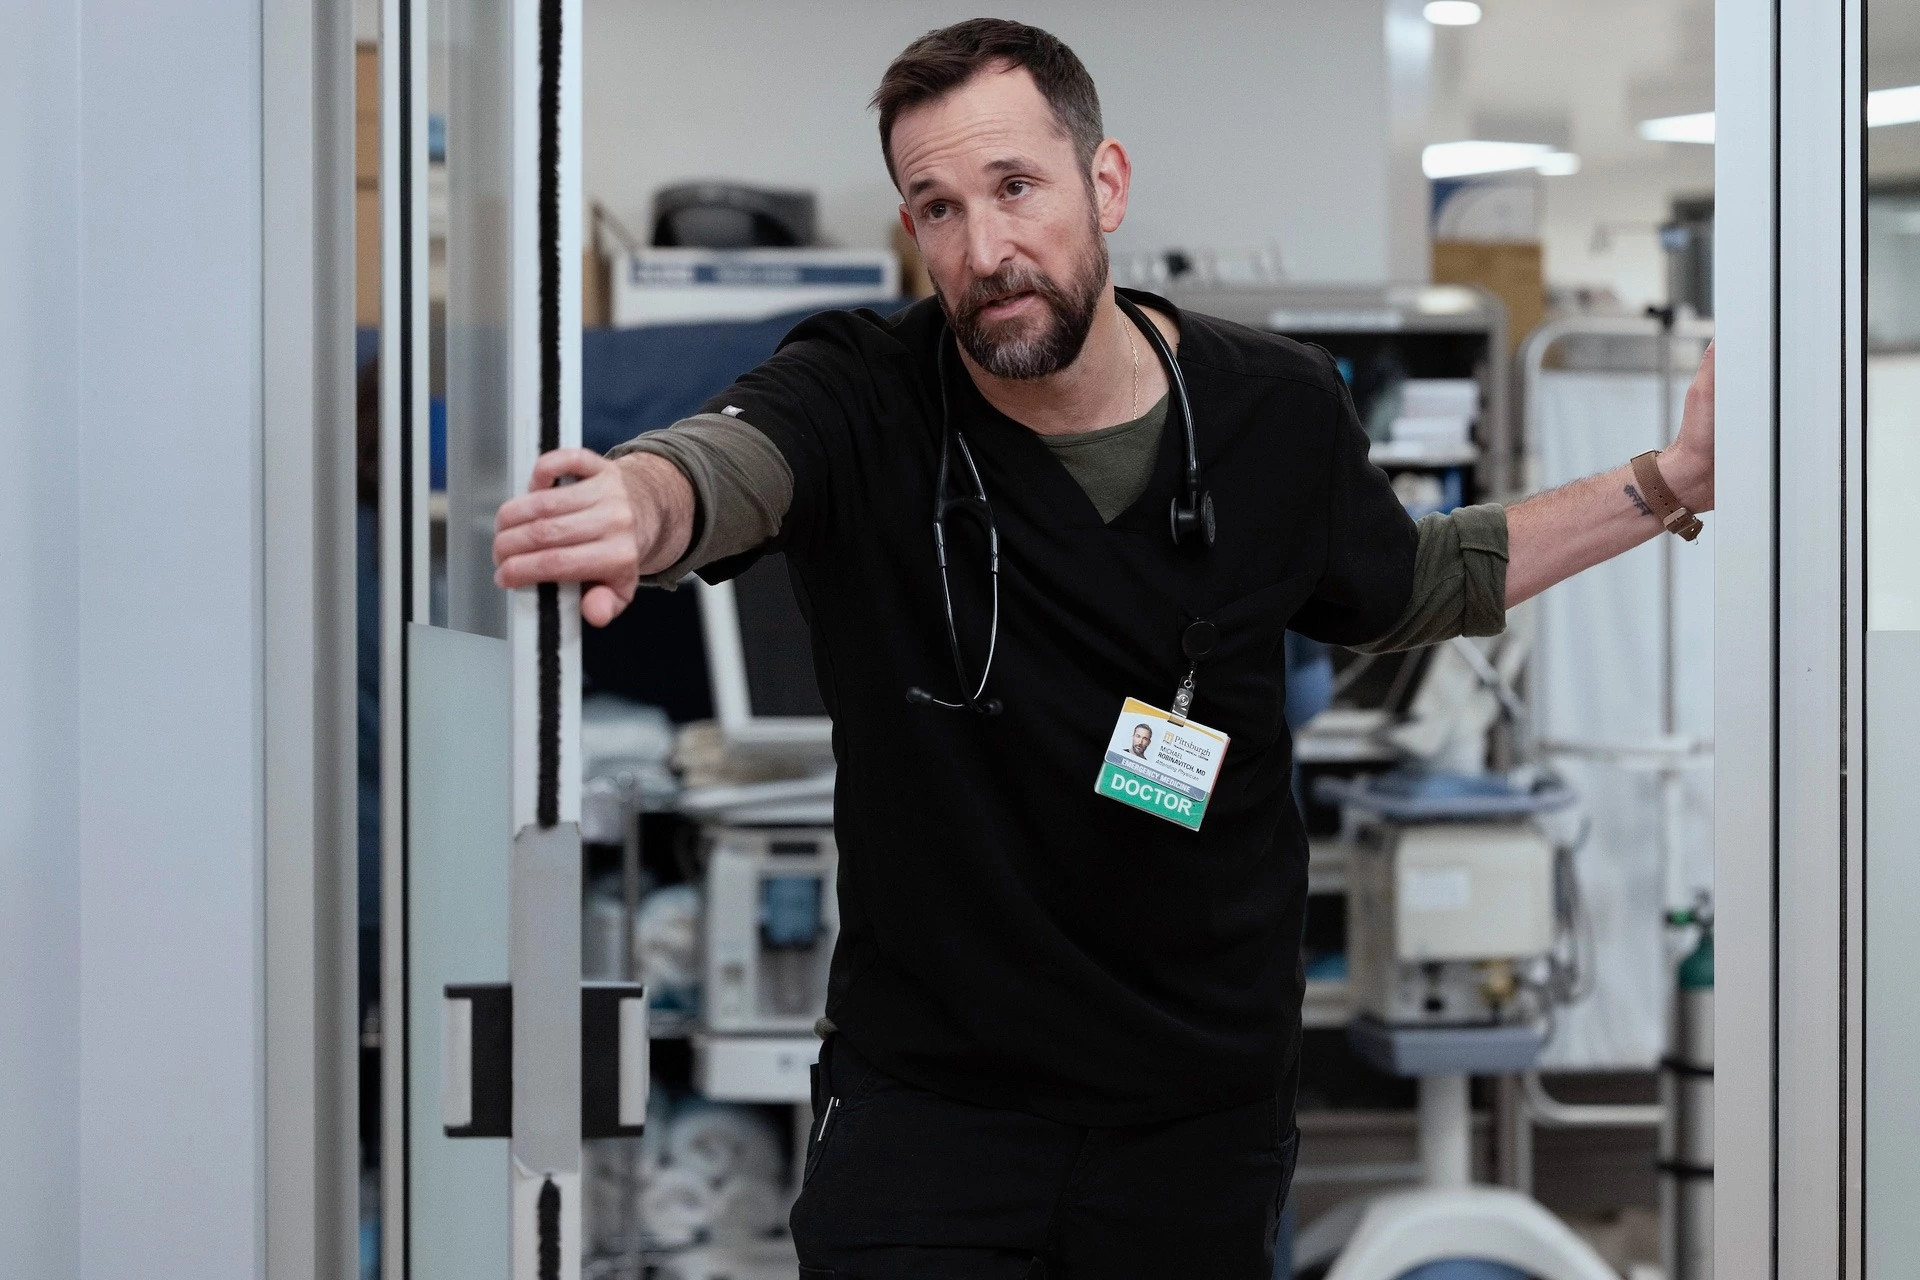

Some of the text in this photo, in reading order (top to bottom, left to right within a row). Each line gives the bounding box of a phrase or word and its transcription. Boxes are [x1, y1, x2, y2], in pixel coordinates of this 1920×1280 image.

[1160, 746, 1183, 760] MICHAEL
[1174, 736, 1211, 757] Pittsburgh
[1121, 758, 1191, 793] EMERGENCY MEDICINE
[1155, 760, 1200, 781] Attending Physician
[1196, 768, 1206, 776] MD
[1111, 773, 1193, 816] DOCTOR
